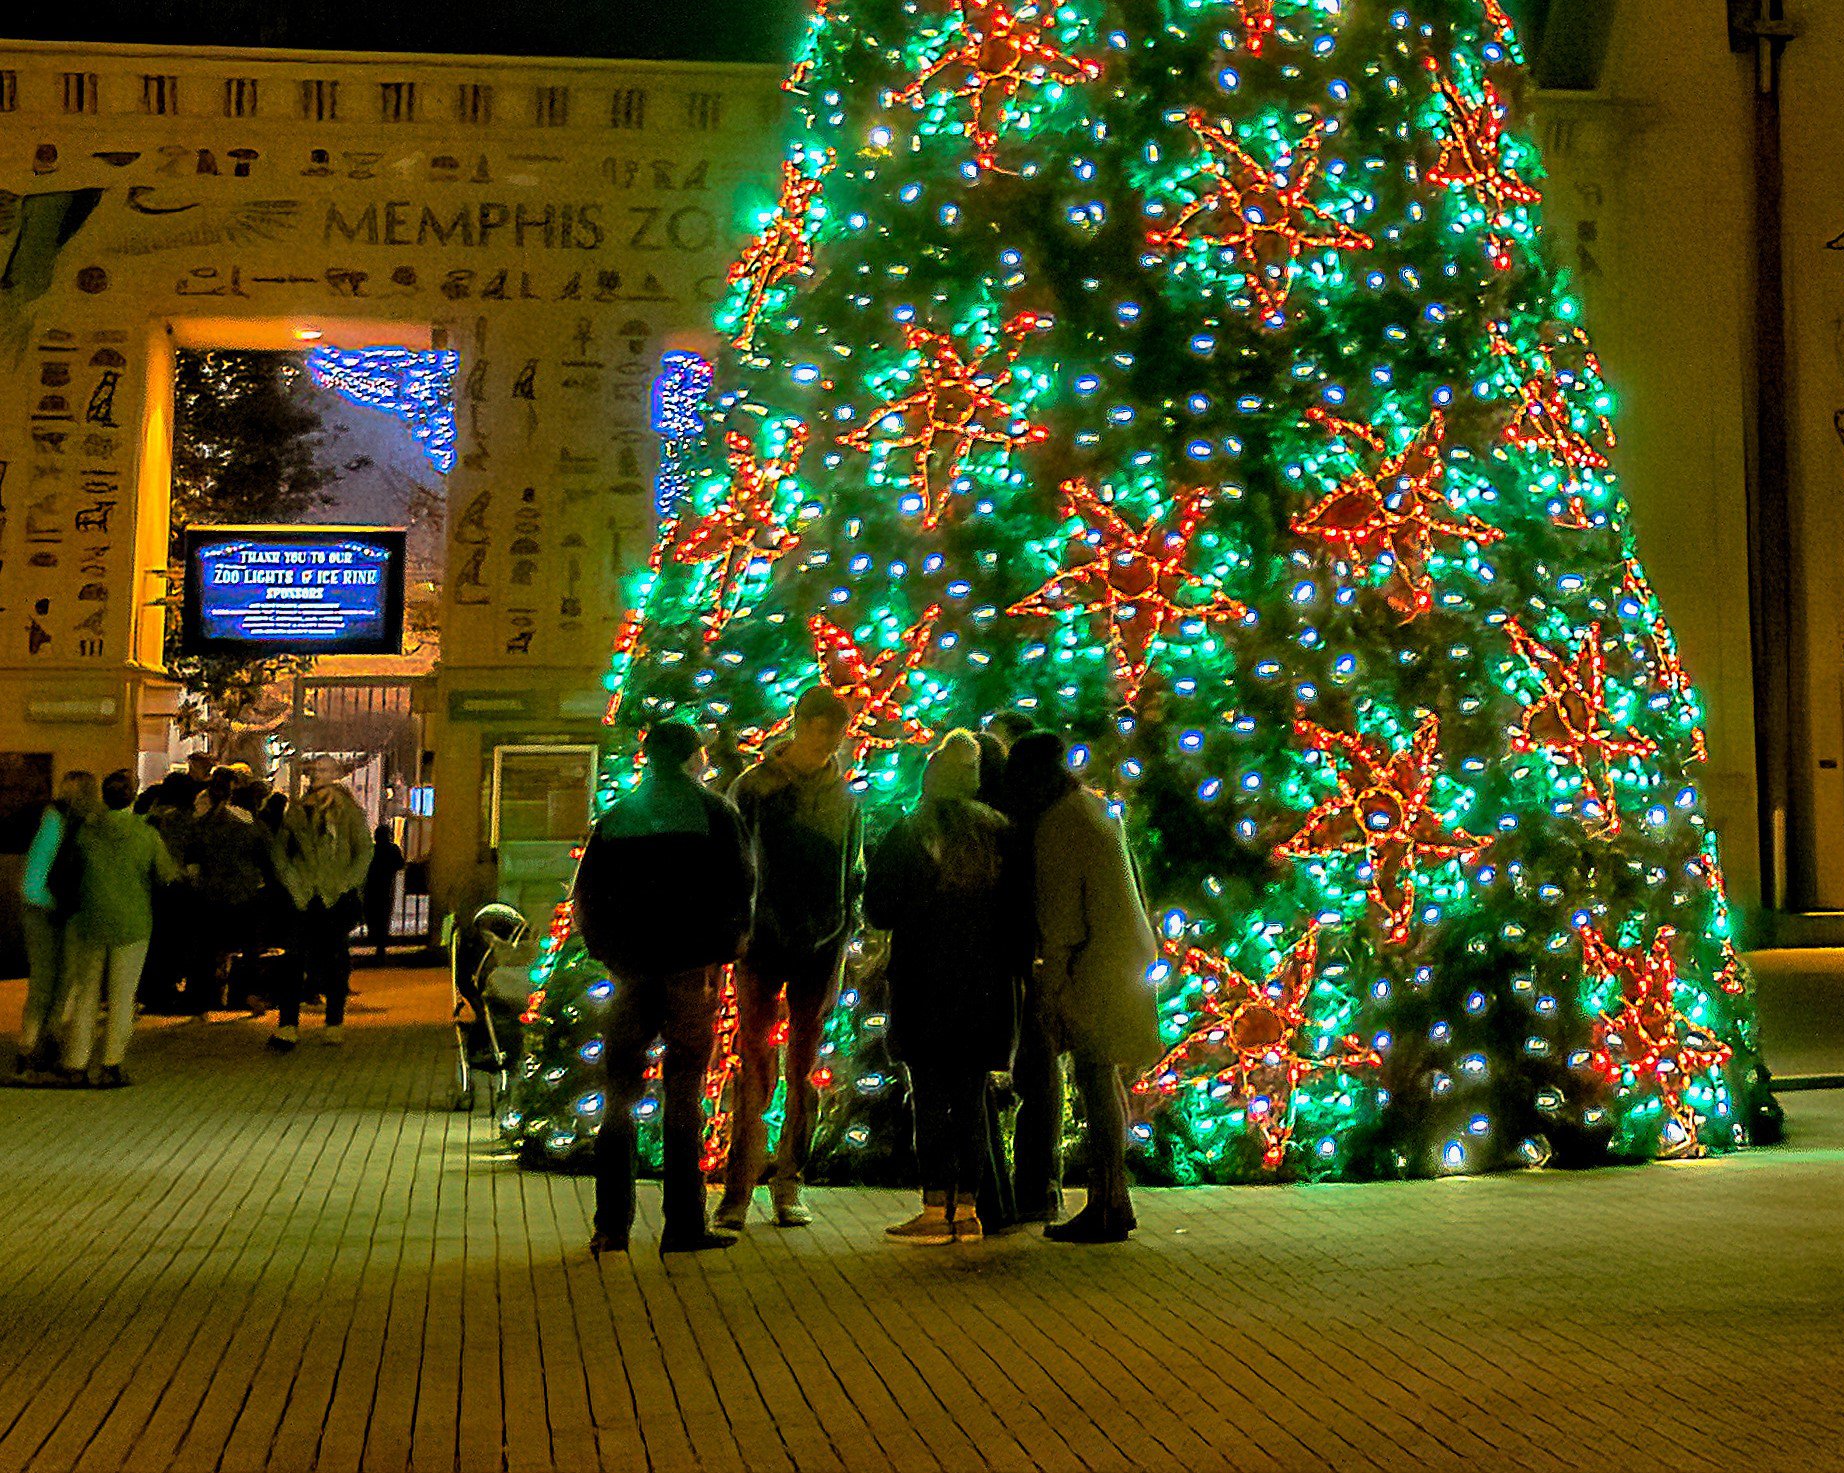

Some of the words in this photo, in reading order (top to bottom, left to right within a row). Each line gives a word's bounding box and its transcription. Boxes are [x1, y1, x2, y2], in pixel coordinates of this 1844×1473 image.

[323, 200, 603, 250] MEMPHIS
[628, 205, 717, 252] ZO
[240, 551, 281, 563] THANK
[284, 551, 307, 564] YOU
[310, 551, 325, 564] TO
[328, 551, 353, 564] OUR
[214, 569, 240, 584] ZOO
[244, 569, 294, 584] LIGHTS
[317, 569, 339, 584] ICE
[342, 569, 378, 584] RINK
